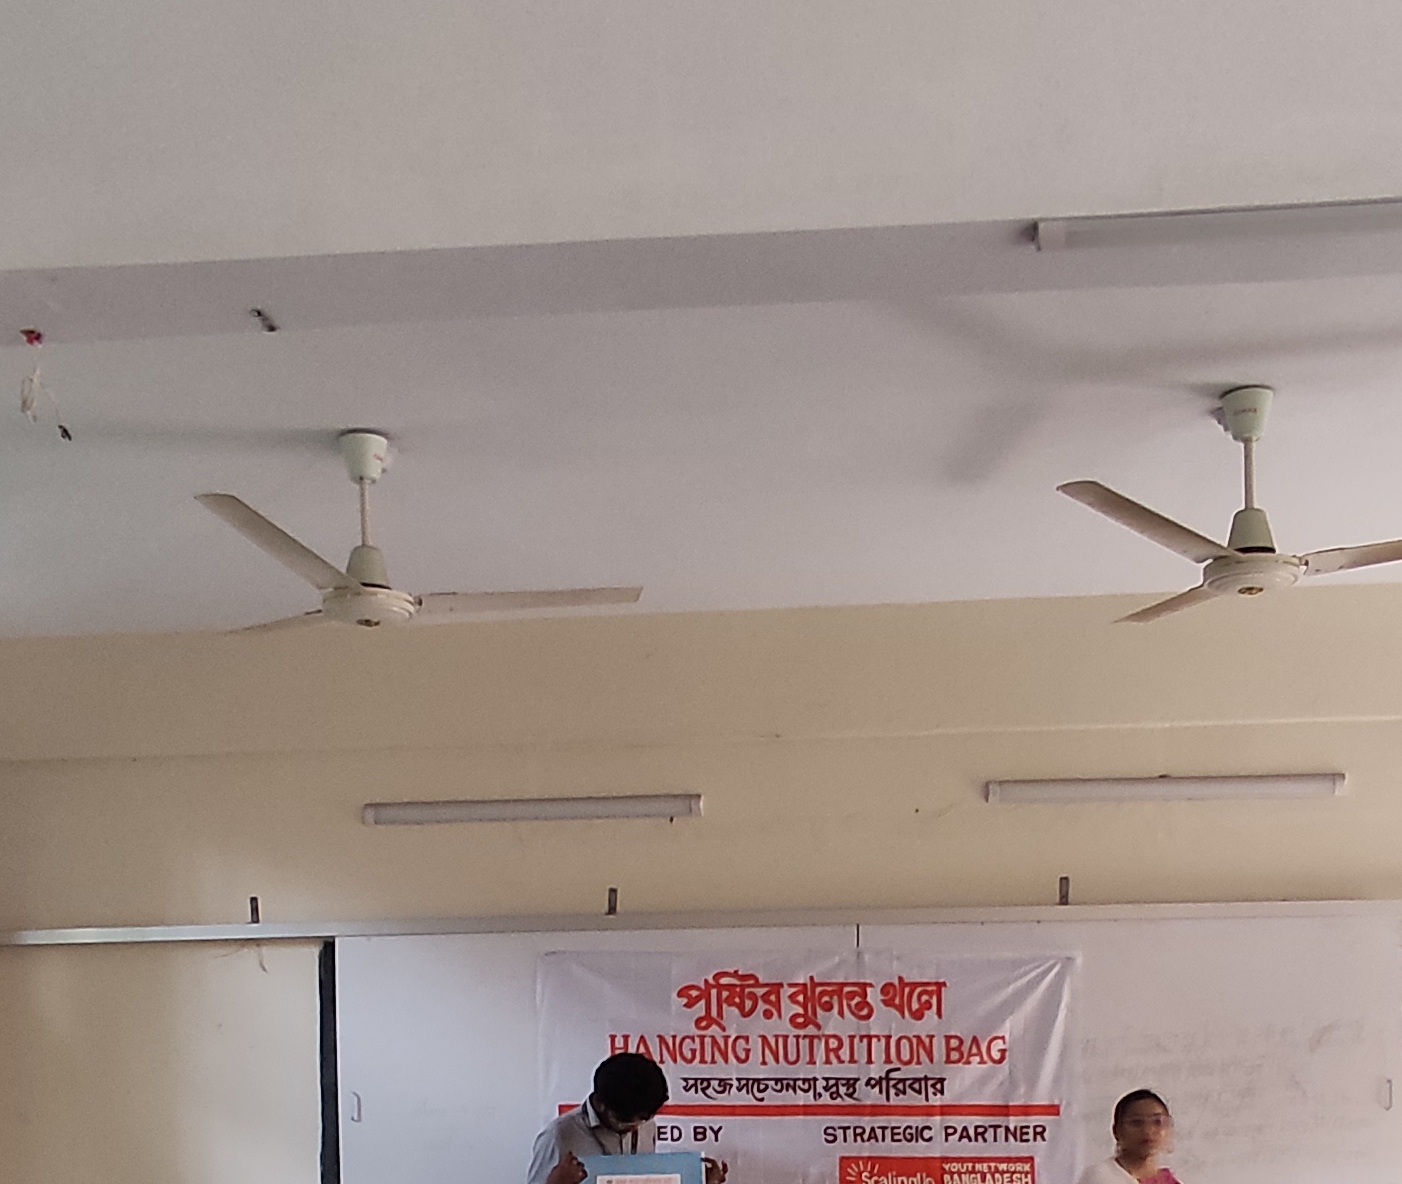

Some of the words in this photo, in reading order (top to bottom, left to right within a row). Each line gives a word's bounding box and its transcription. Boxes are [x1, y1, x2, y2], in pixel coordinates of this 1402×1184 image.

[677, 970, 784, 1032] পুষ্টির
[787, 975, 874, 1031] ঝুলন্ত
[880, 975, 947, 1021] থলে
[608, 1034, 751, 1065] HANGING
[758, 1034, 935, 1066] NUTRITION
[943, 1033, 1008, 1066] BAG
[680, 1076, 733, 1100] সহজ
[865, 1067, 946, 1102] পরিবার
[693, 1125, 723, 1143] BY
[823, 1125, 933, 1144] STRATEGIC
[944, 1124, 1047, 1143] PARTNER
